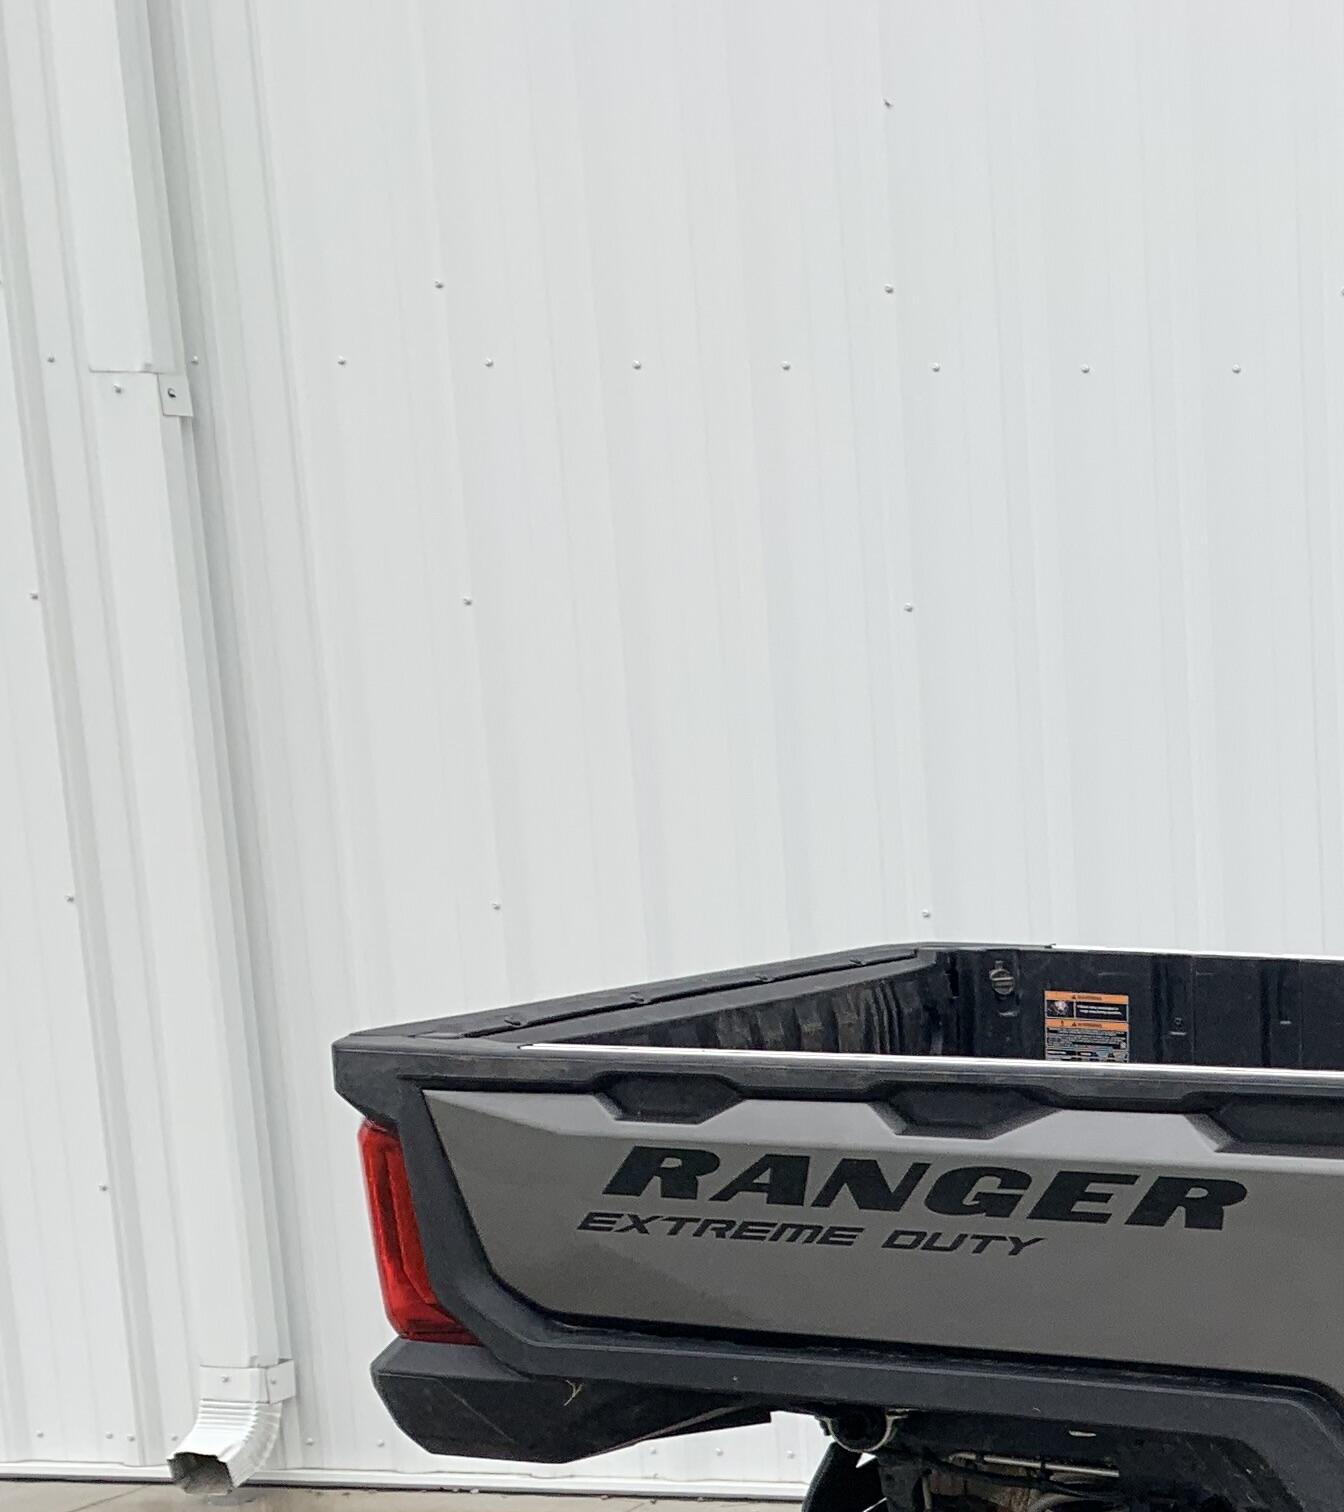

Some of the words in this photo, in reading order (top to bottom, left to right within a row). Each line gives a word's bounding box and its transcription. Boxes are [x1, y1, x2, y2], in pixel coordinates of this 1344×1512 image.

[602, 1145, 1248, 1231] RANGER
[577, 1212, 866, 1247] EXTREME
[882, 1230, 1047, 1256] DUTY
